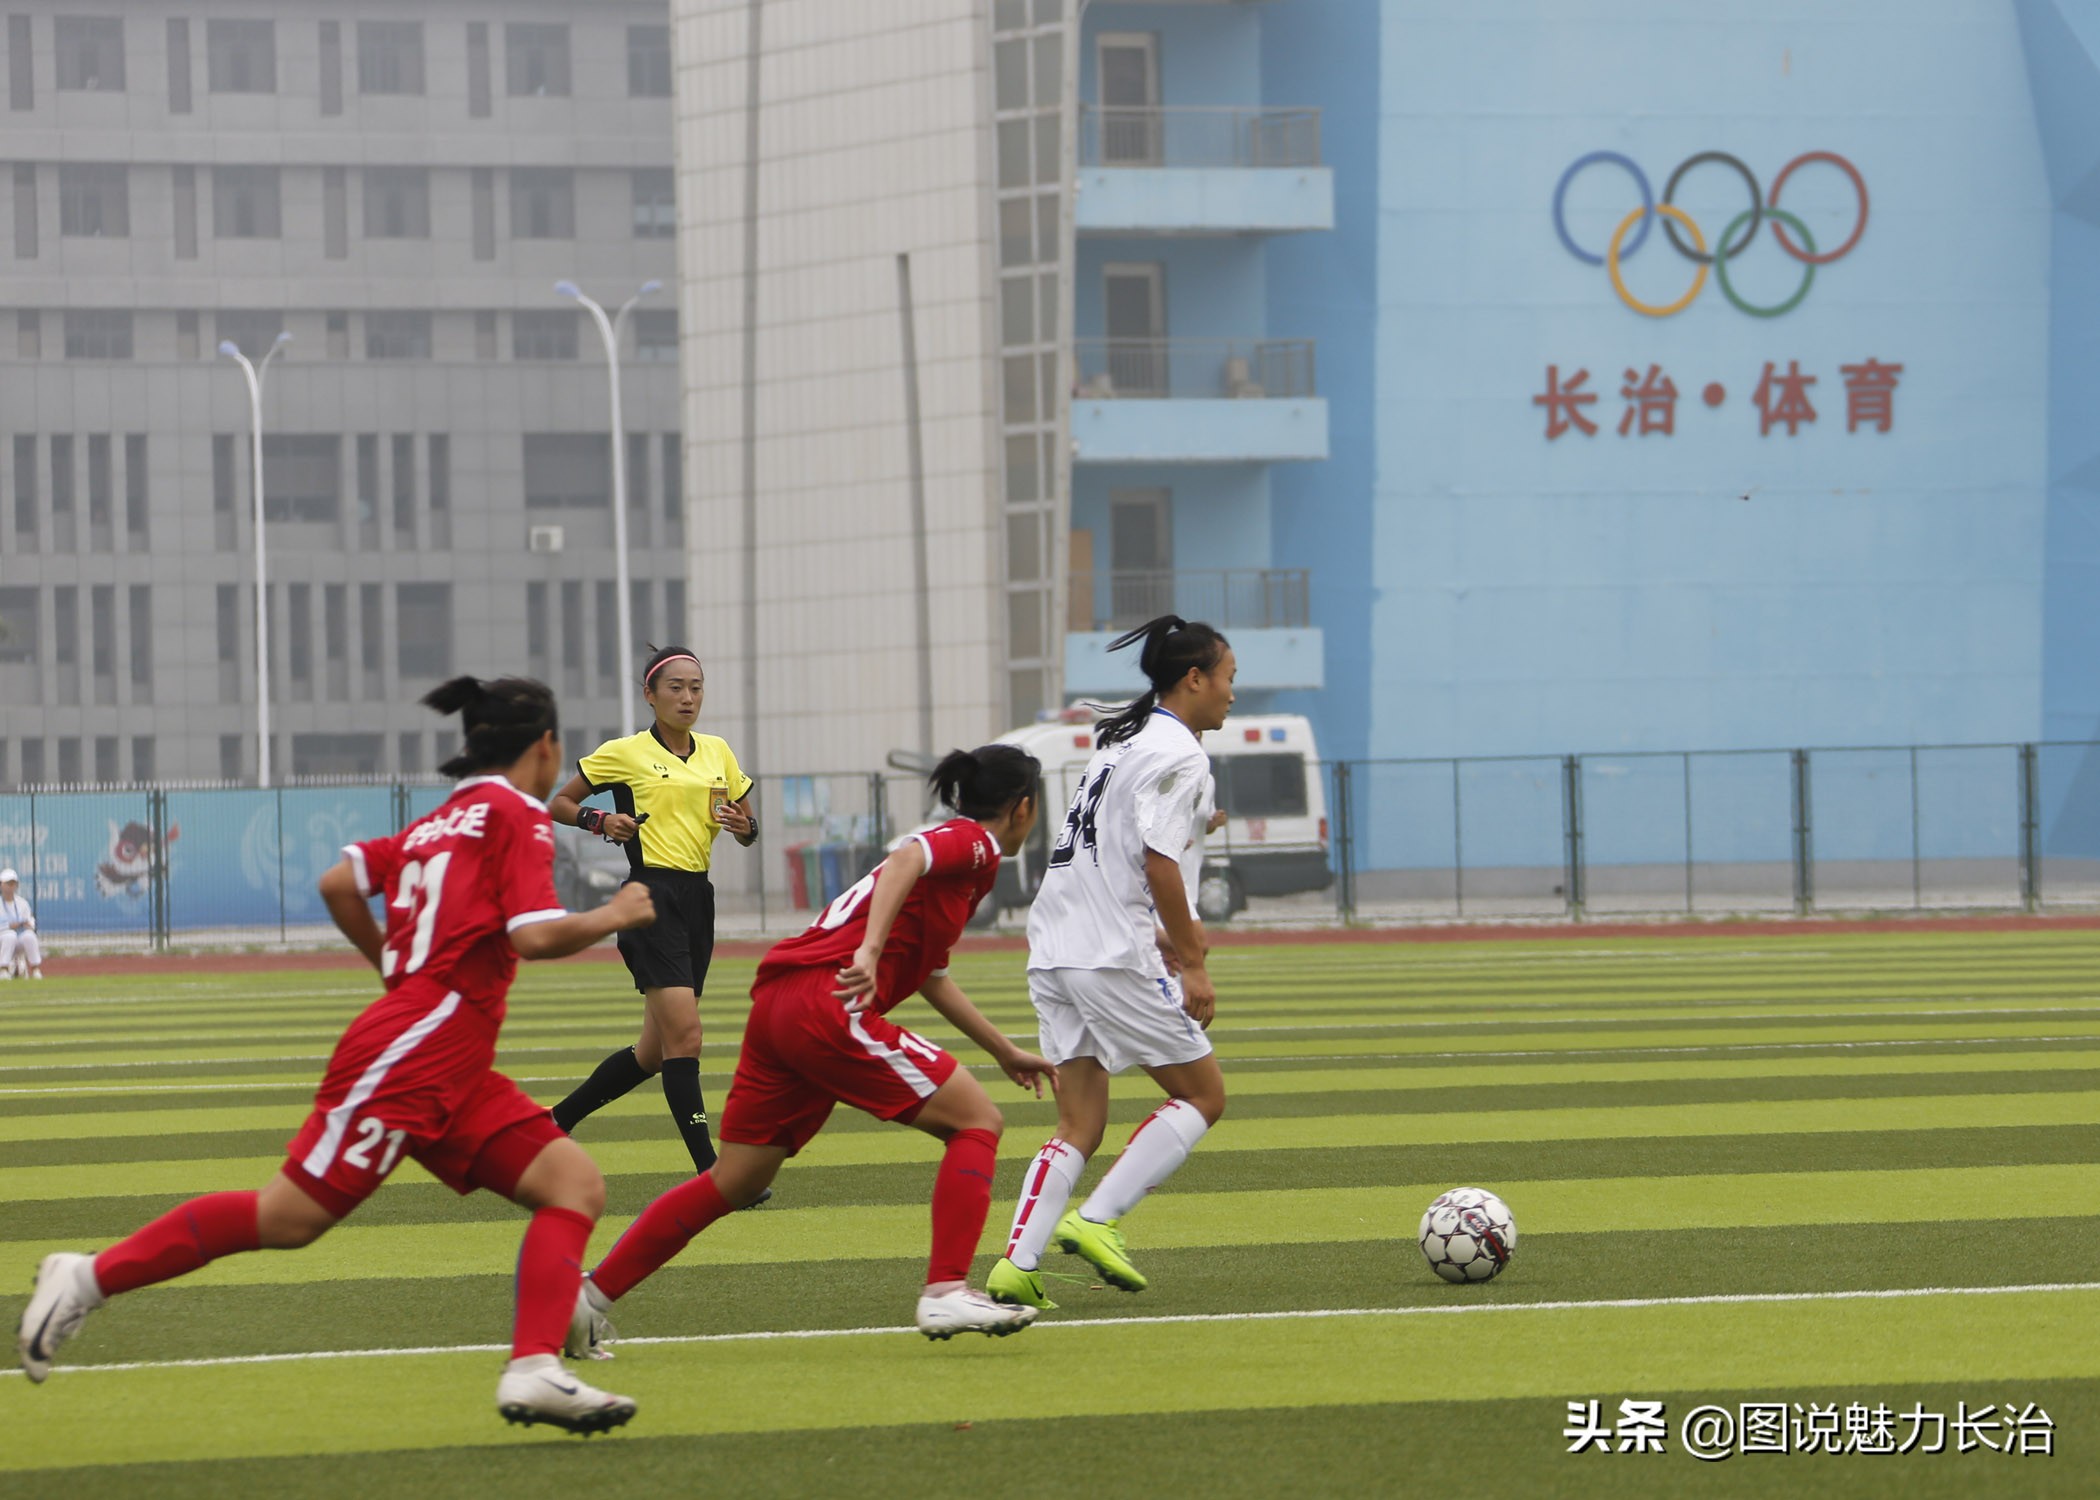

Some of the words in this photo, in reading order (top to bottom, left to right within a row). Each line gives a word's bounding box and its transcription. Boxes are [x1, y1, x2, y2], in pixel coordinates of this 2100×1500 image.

[1532, 357, 1904, 441] 长治·体育
[343, 1116, 407, 1175] 21
